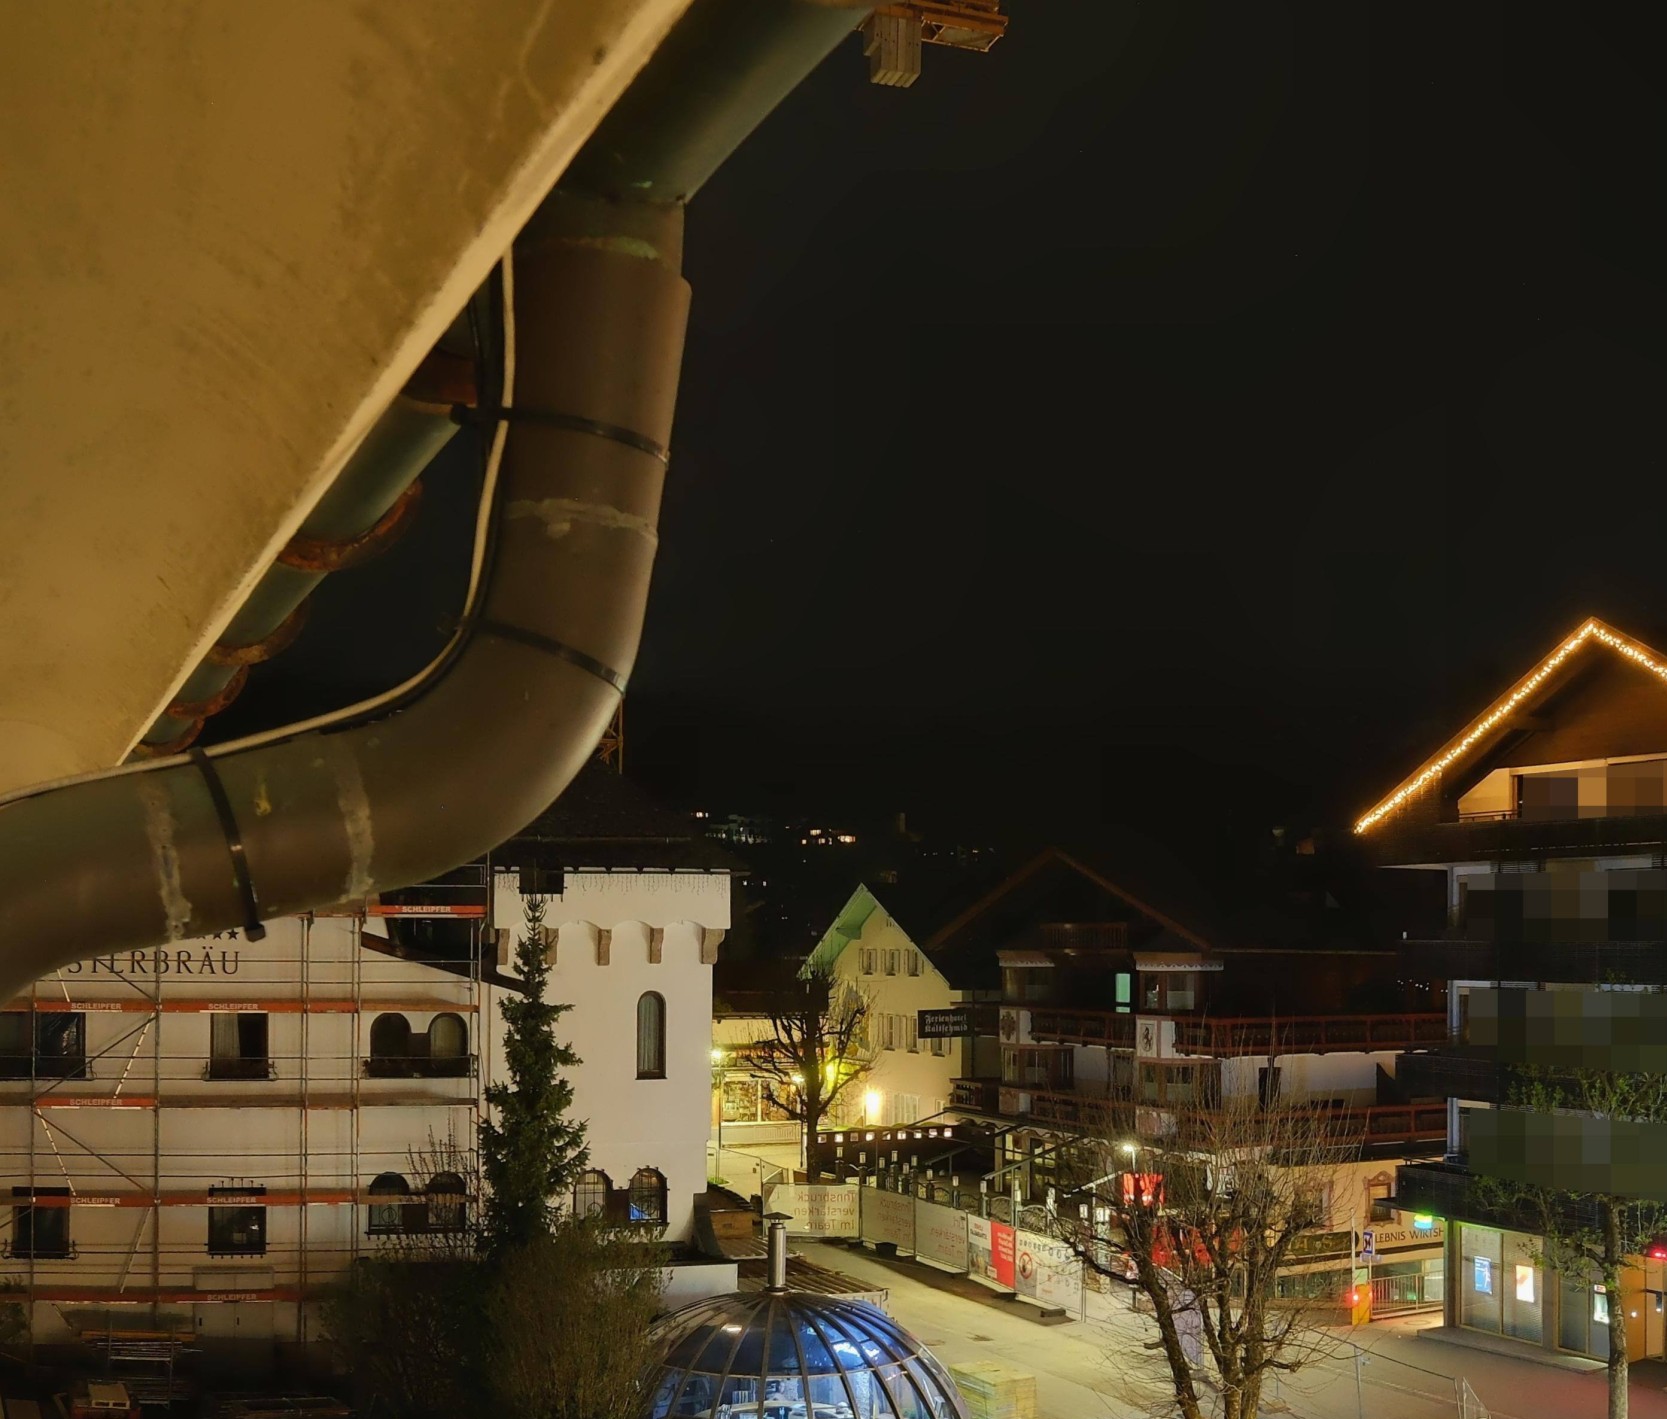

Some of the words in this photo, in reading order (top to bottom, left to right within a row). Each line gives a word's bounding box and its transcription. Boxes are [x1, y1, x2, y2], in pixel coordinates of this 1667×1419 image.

[71, 1002, 121, 1010] SCHLEIPFER
[70, 1098, 122, 1106] SCHLEIPFER
[207, 1293, 257, 1301] SCHLEIPFER
